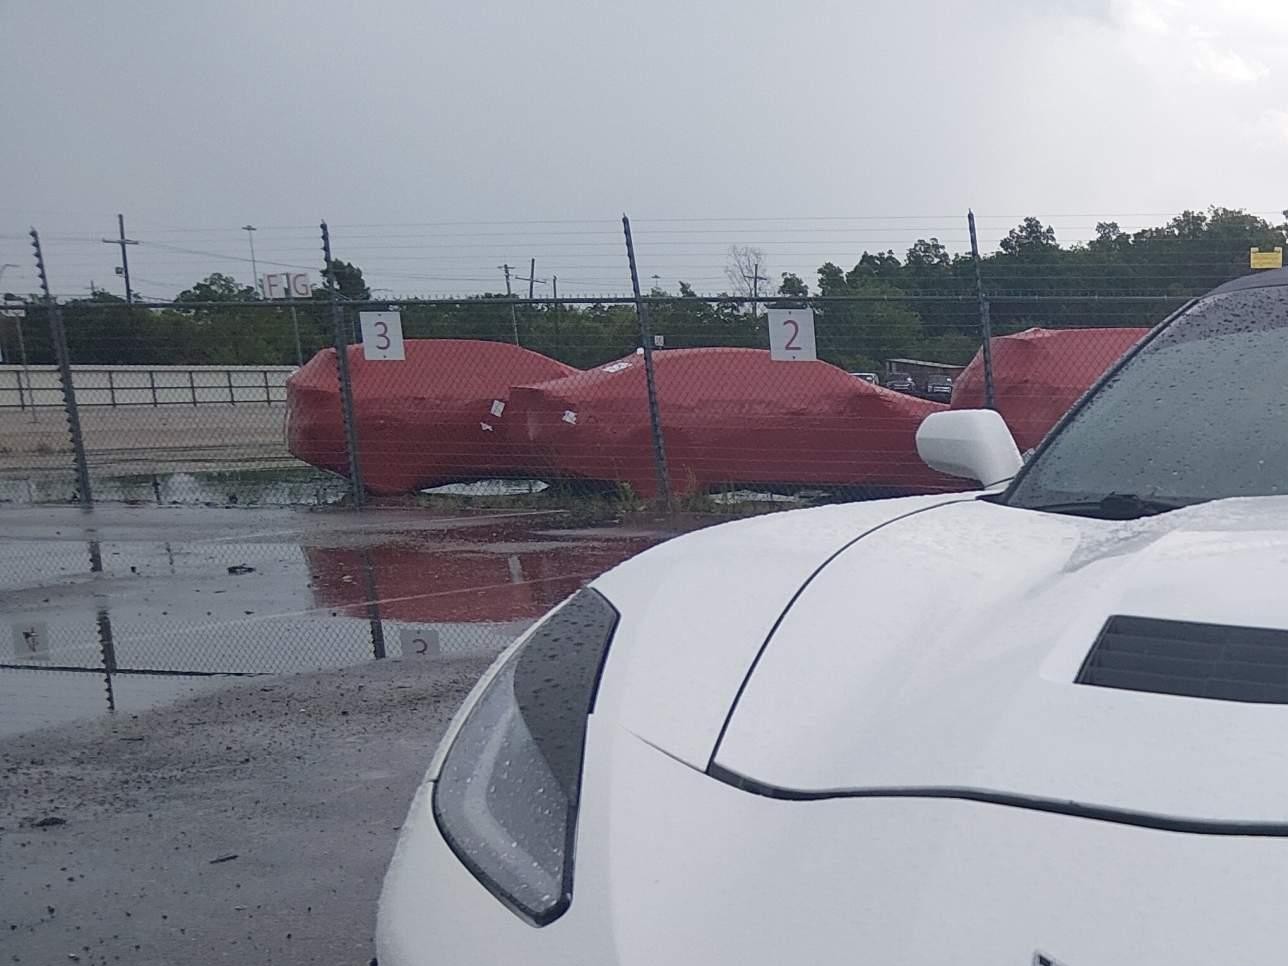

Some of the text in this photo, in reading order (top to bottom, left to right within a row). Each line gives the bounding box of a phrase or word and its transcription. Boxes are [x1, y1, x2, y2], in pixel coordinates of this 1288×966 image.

[266, 274, 309, 297] F G
[373, 321, 391, 350] 3
[783, 319, 803, 351] 2
